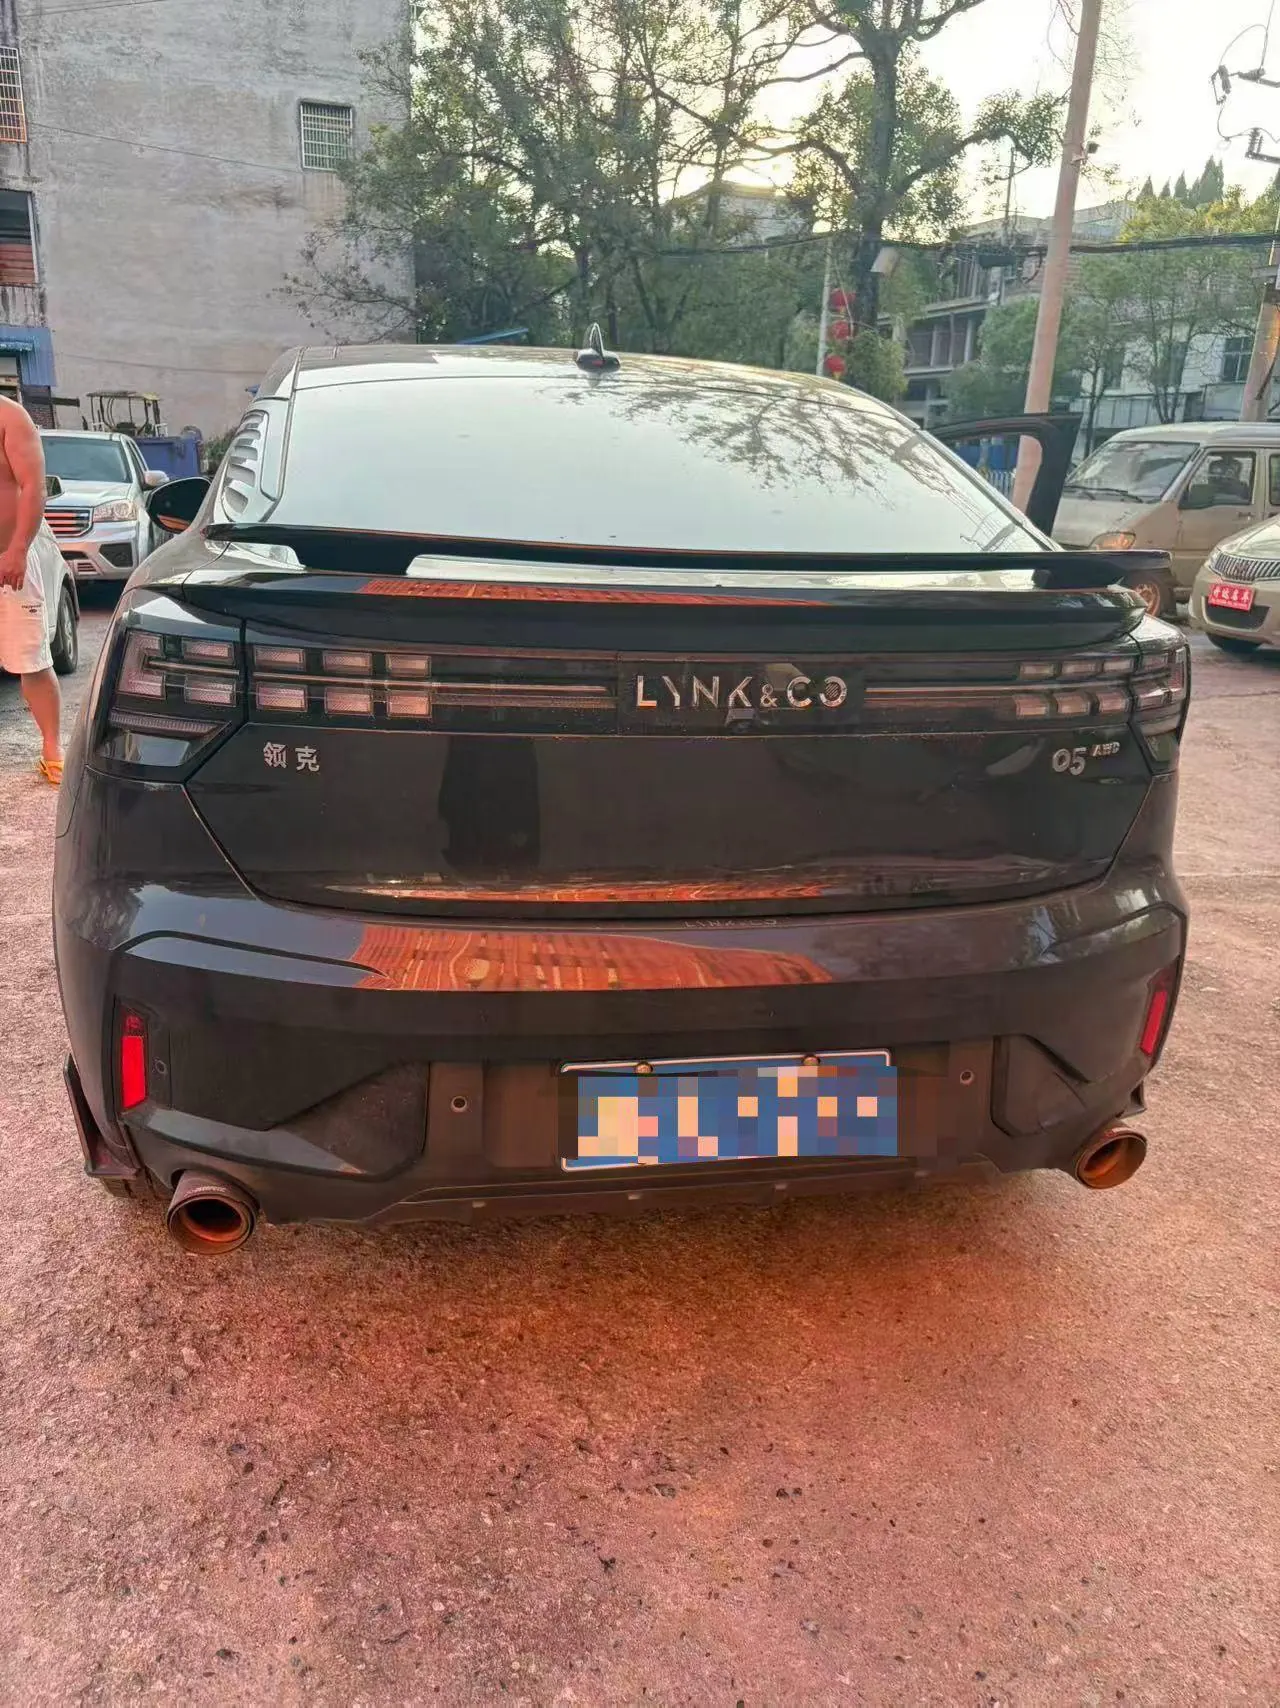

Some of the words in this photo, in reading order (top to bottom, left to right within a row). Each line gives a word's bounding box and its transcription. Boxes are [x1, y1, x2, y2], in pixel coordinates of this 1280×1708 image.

[636, 675, 848, 708] LYNK&CO
[263, 741, 320, 772] 领克
[1052, 747, 1087, 776] 05
